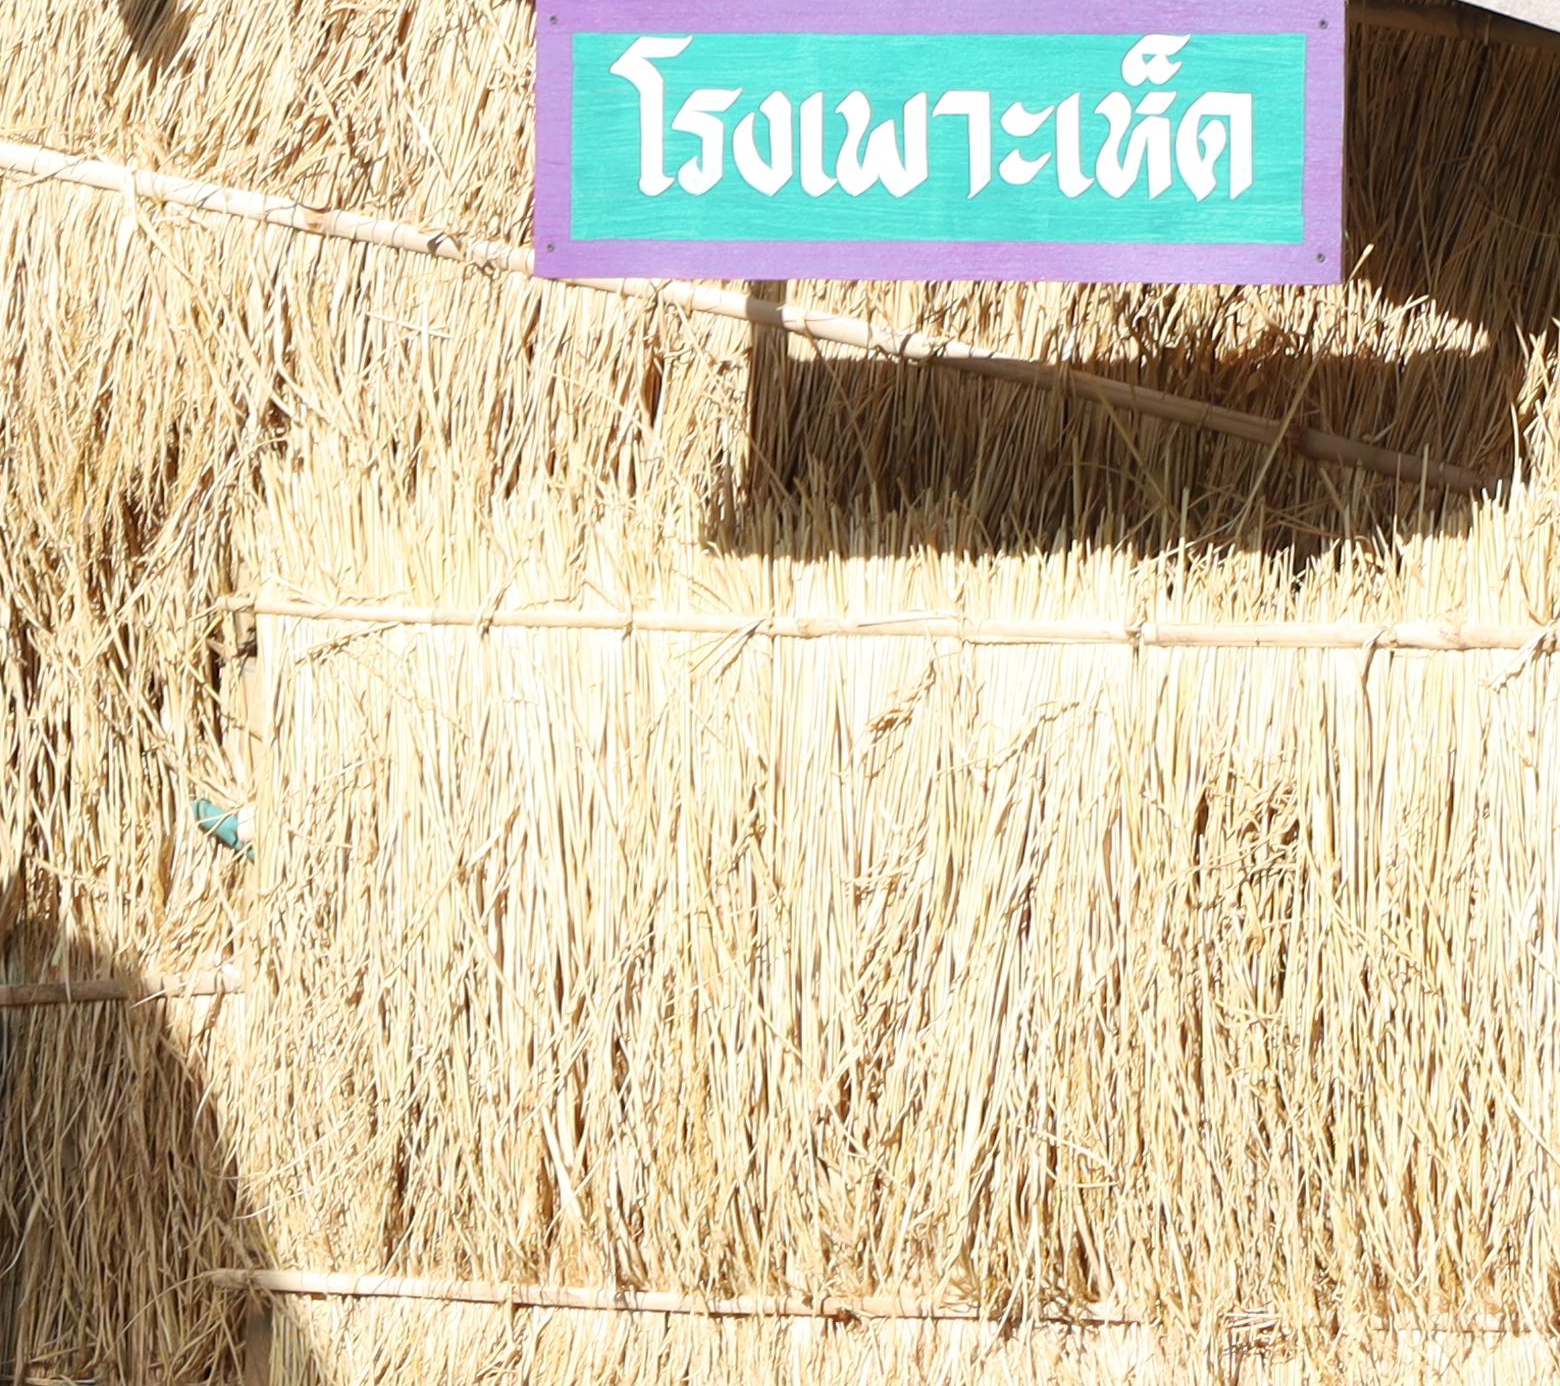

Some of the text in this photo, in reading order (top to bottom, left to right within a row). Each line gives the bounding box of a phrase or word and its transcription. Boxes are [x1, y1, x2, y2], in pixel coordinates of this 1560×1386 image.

[609, 33, 1254, 203] โรงเพาะเห็ด
